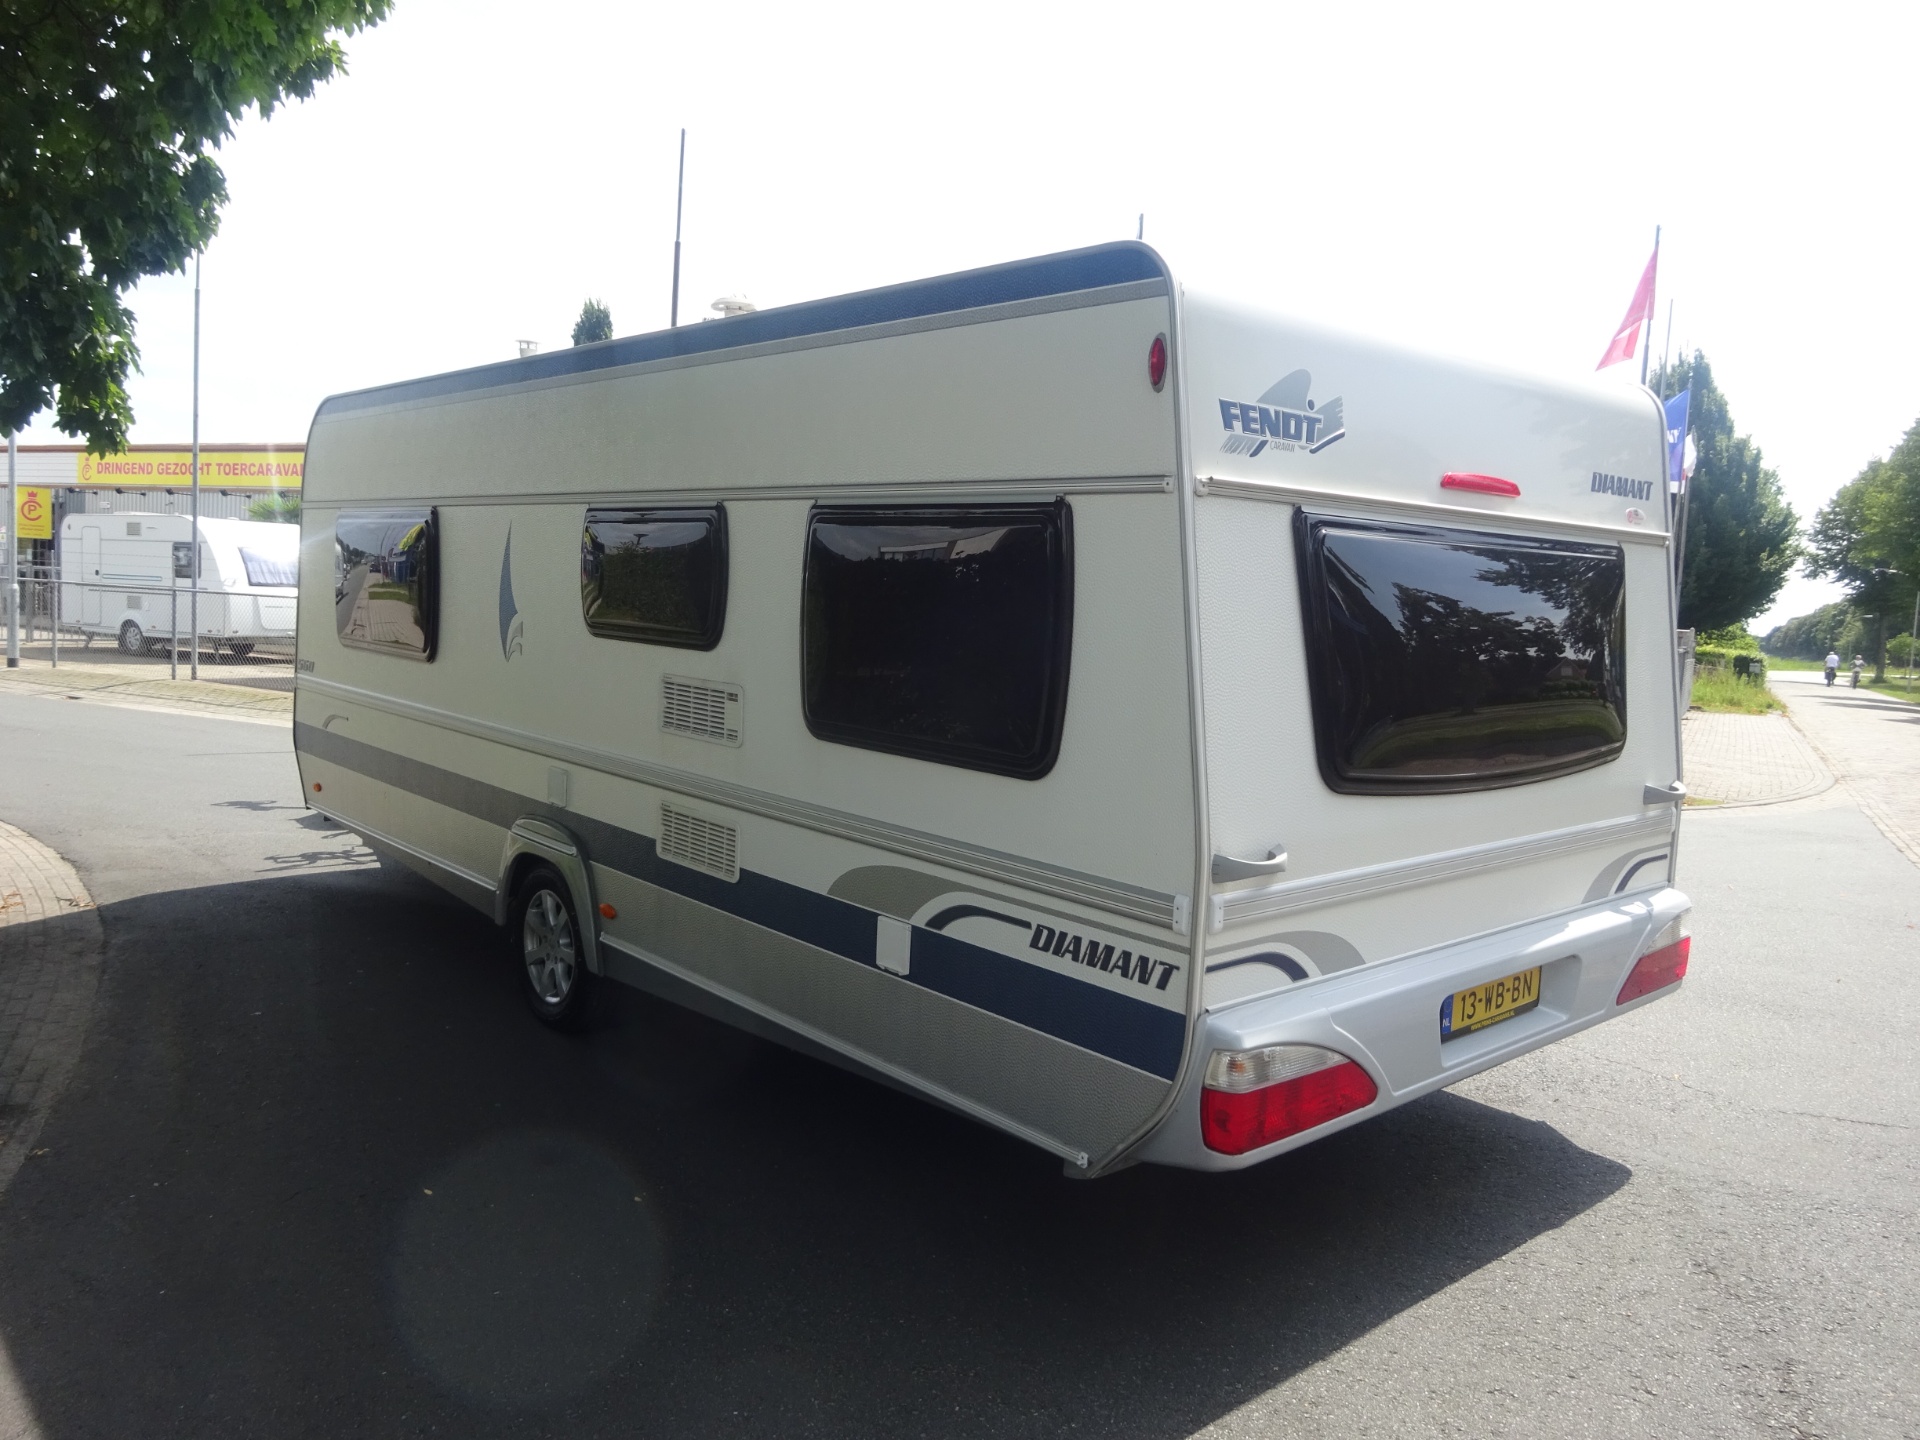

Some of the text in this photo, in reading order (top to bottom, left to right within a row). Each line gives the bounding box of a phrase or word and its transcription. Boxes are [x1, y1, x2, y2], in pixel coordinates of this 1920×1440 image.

[1218, 398, 1323, 445] FENDT
[1270, 440, 1295, 453] CARAVAN
[97, 462, 153, 475] DRINGEND
[1590, 471, 1653, 501] DIAMANT
[1029, 923, 1180, 991] DIAMANT
[1461, 970, 1533, 1022] 13-WB-BN
[1442, 1017, 1451, 1027] NL
